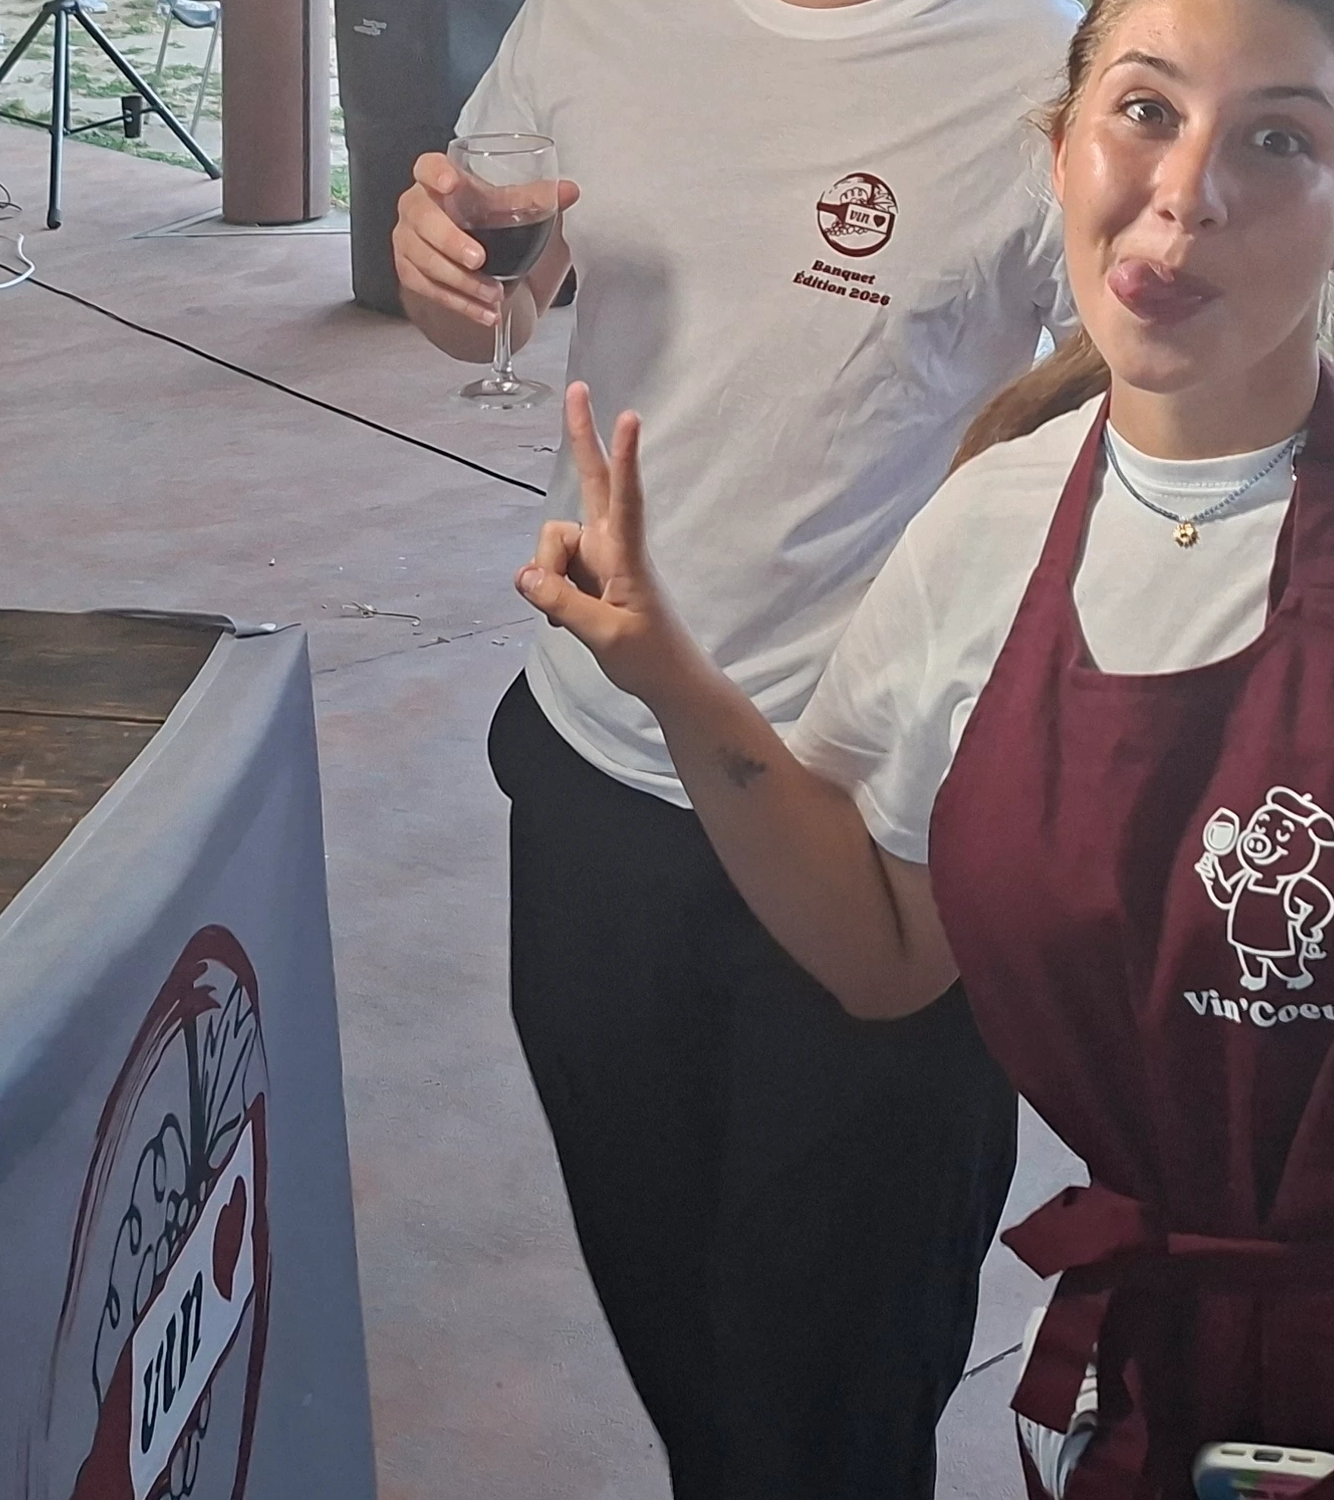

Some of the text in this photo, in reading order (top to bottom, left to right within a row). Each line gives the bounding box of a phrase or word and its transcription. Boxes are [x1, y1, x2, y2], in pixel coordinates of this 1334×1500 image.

[811, 260, 876, 285] Banquet
[793, 270, 891, 307] Édition 2026
